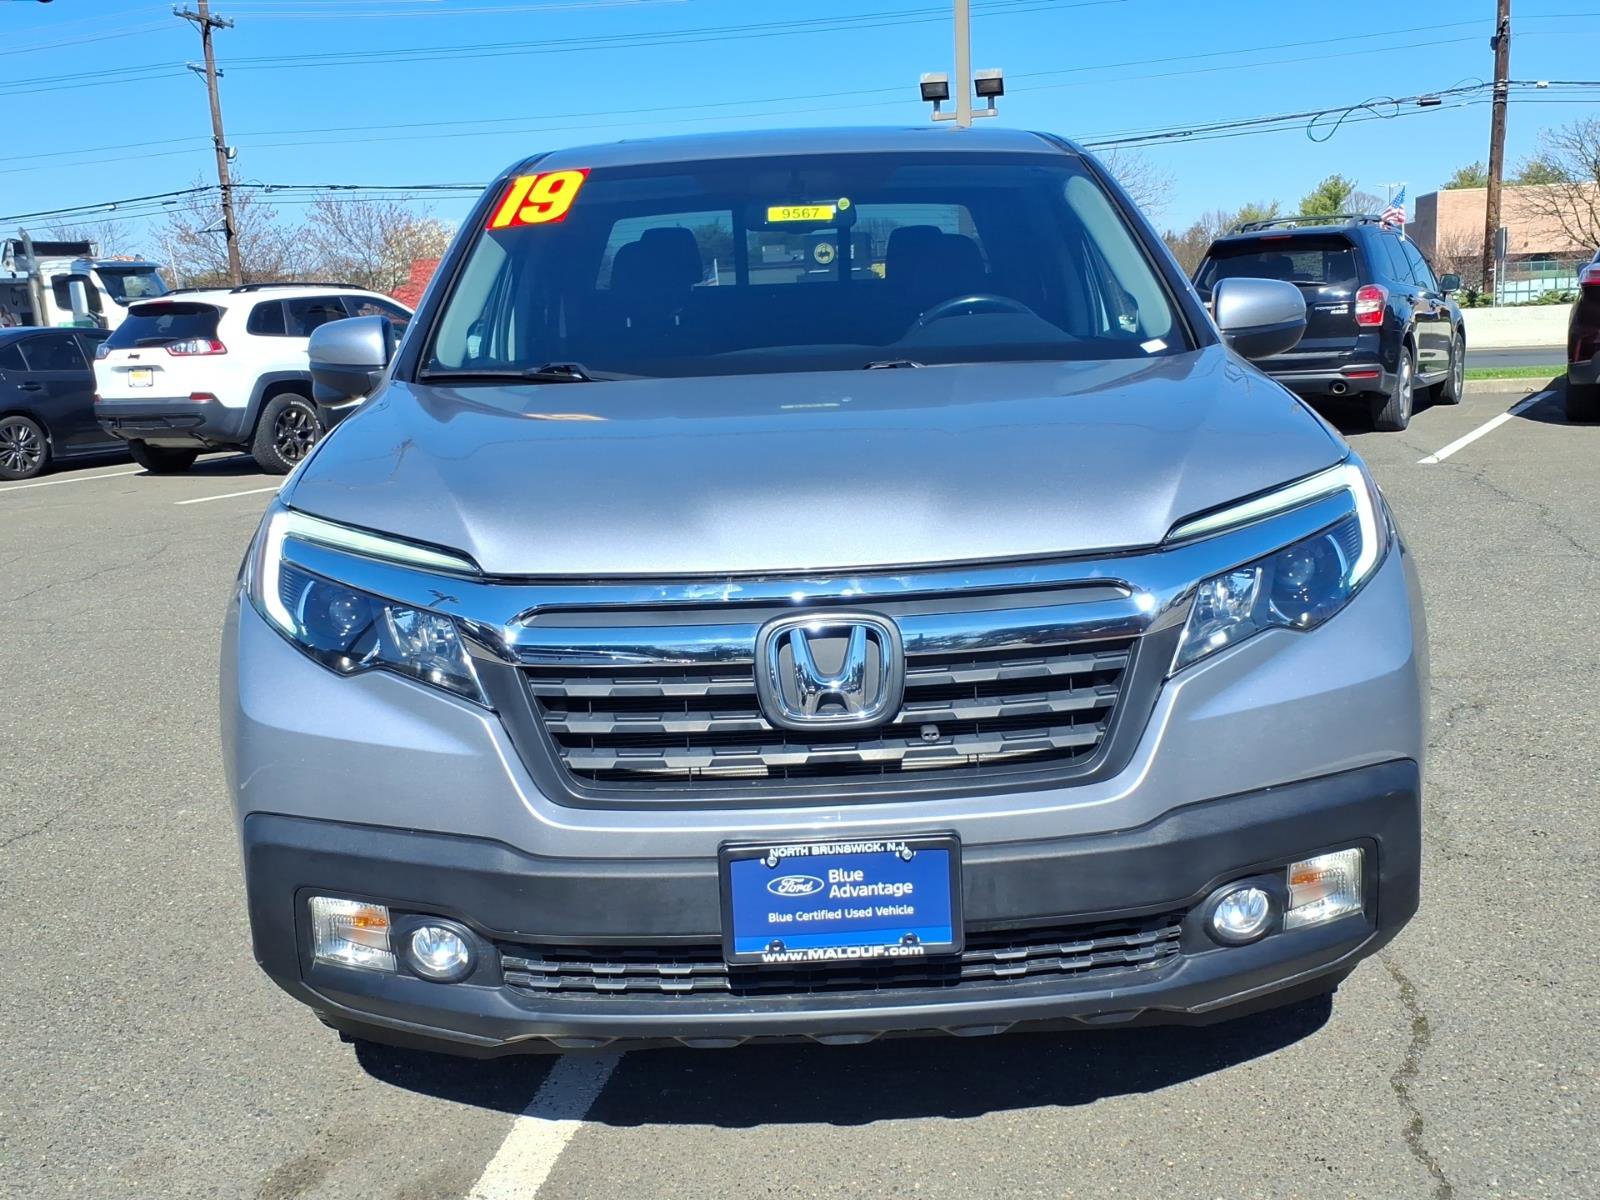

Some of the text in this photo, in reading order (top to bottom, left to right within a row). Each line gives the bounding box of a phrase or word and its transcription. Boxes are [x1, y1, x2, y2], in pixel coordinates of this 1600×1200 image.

[492, 171, 585, 228] 19
[782, 207, 820, 219] 9567
[769, 846, 809, 858] NORTH
[828, 868, 864, 883] Blue
[778, 877, 813, 893] Ford
[829, 882, 913, 898] Advantage
[767, 904, 915, 923] Blue Certified Used Vehicle
[761, 945, 924, 962] www.MALOUF.com
